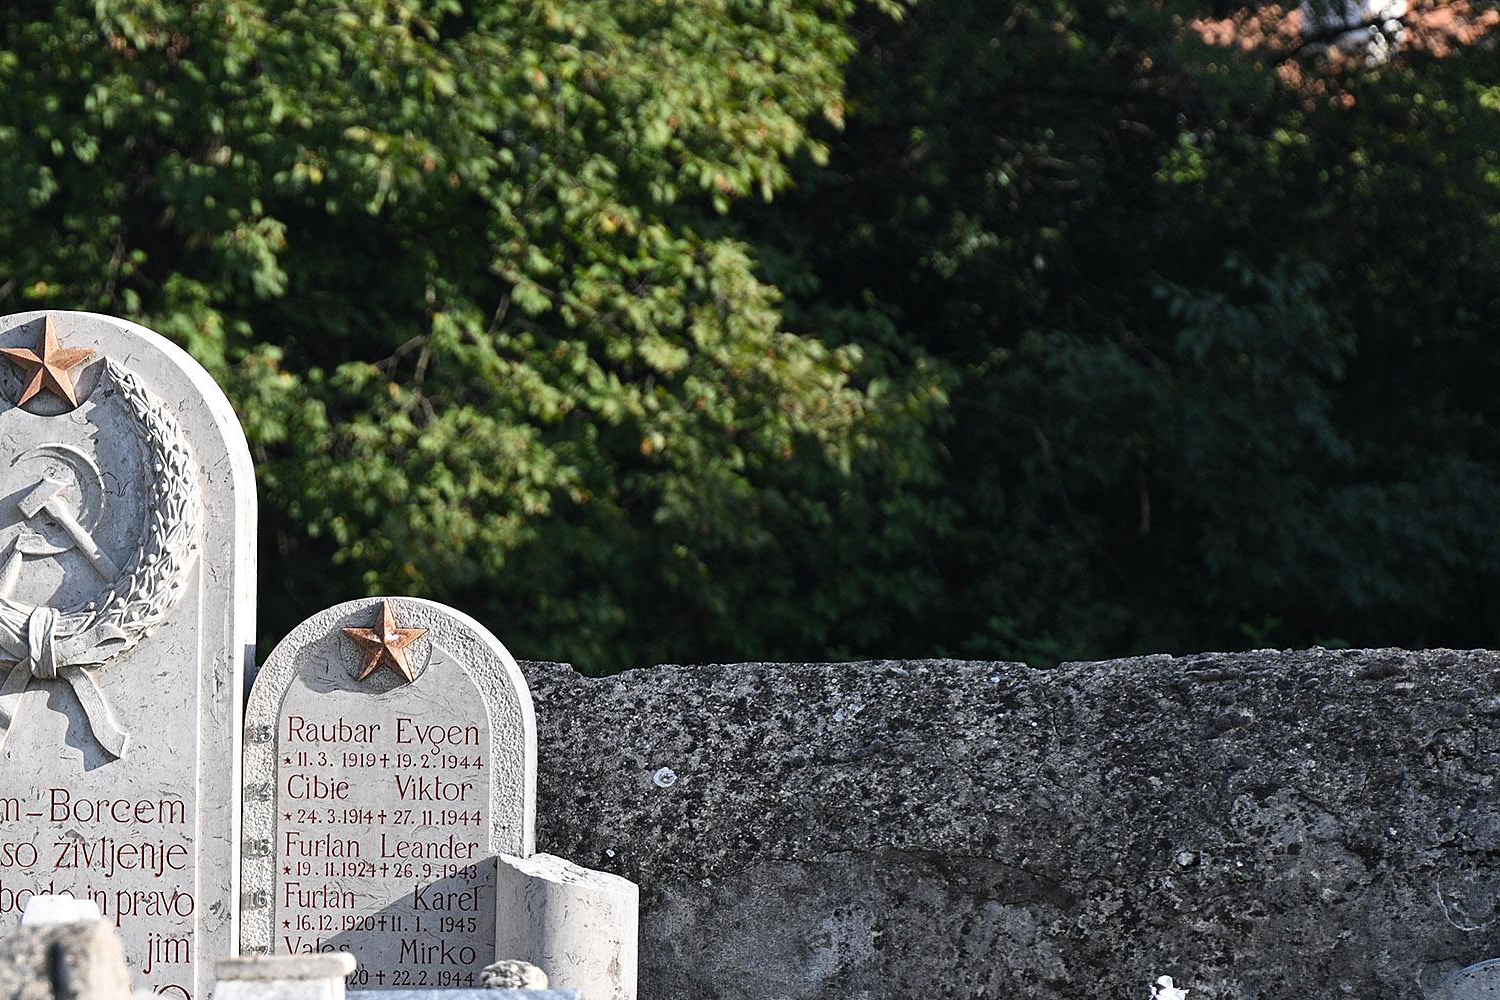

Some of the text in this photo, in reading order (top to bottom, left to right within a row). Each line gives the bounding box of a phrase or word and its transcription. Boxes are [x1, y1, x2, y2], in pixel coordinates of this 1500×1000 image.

[287, 715, 480, 756] Raubar Evgen
[342, 752, 376, 768] 1919
[394, 774, 474, 801] Viktor
[49, 788, 186, 824] Borcem
[0, 842, 38, 868] so
[53, 835, 188, 878] življenje
[284, 831, 480, 859] Furlan Leander
[115, 887, 195, 927] pravo
[283, 882, 480, 912] Furlan Karel
[142, 932, 191, 975] jim
[398, 937, 476, 965] Mirko
